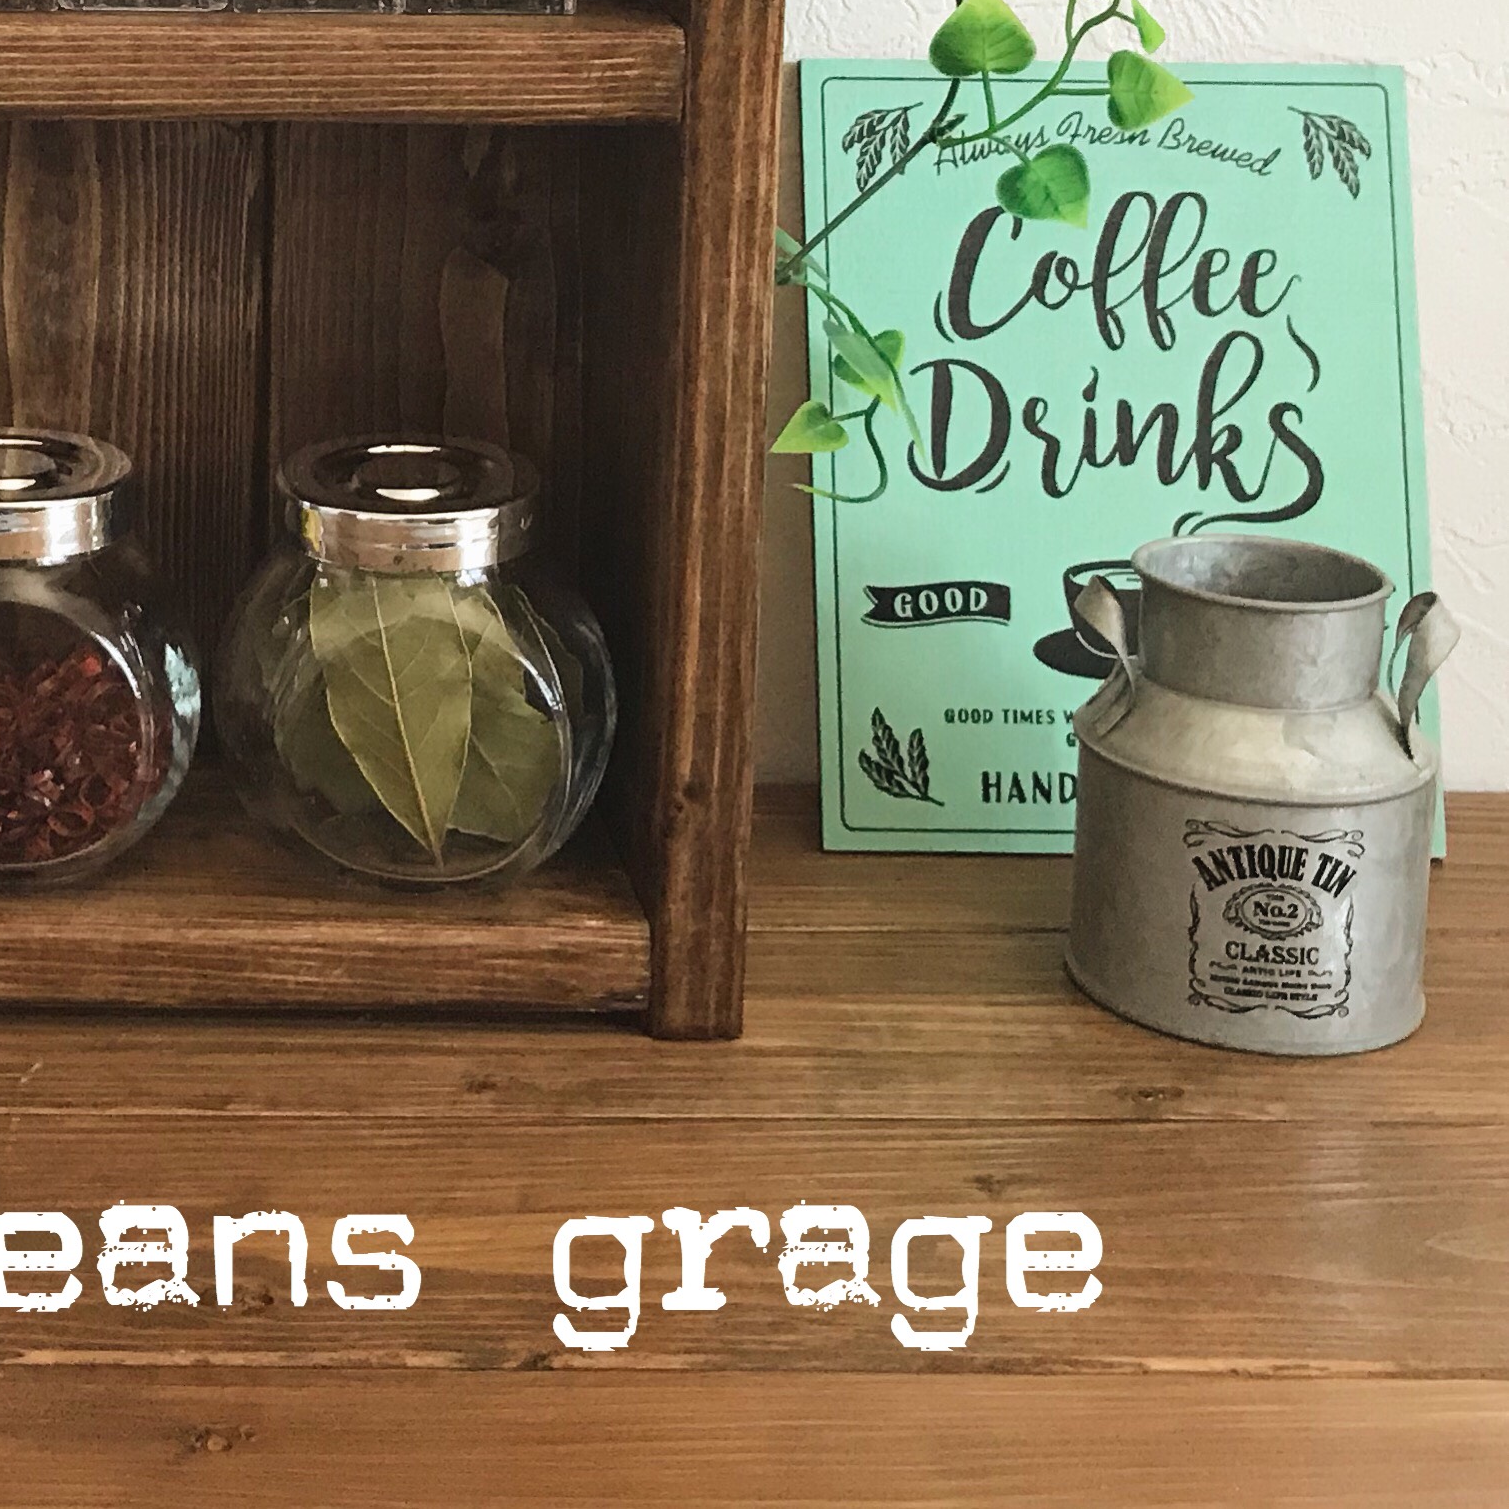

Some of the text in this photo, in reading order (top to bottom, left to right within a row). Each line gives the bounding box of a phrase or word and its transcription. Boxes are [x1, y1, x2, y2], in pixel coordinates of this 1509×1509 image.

[1157, 117, 1284, 177] Brewed
[945, 190, 1302, 351] Coffee
[907, 329, 1325, 529] Drinks
[893, 586, 989, 617] GOOD
[944, 708, 993, 724] GOOD
[1002, 708, 1055, 725] TIMES
[1192, 843, 1357, 899] ANTIQUE TIN
[1225, 940, 1319, 966] CLASSIC
